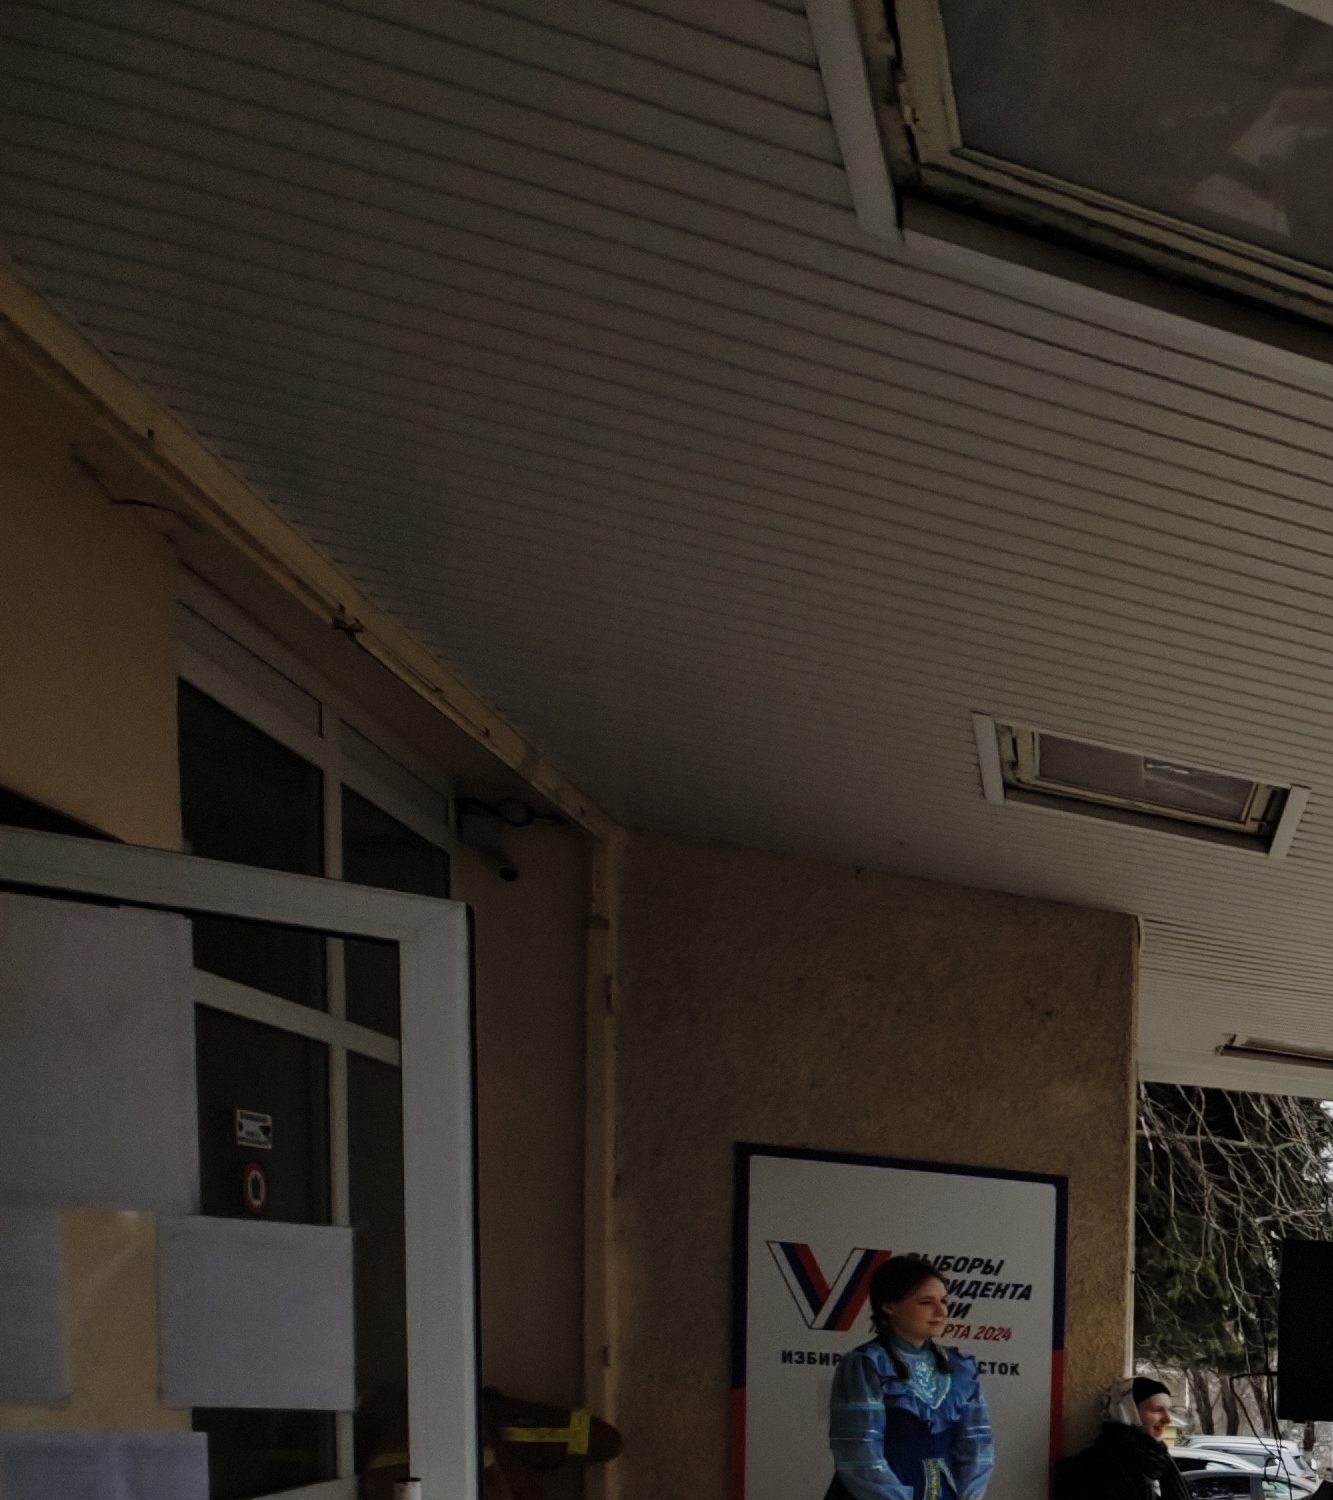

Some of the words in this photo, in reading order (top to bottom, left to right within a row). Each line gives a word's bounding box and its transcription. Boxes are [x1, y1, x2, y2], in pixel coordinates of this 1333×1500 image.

[946, 1279, 1033, 1301] ИДЕНТА
[941, 1323, 972, 1340] РТА
[973, 1325, 1013, 1342] 2024
[781, 1350, 842, 1366] ИЗБИР
[977, 1361, 1020, 1376] СТОК
